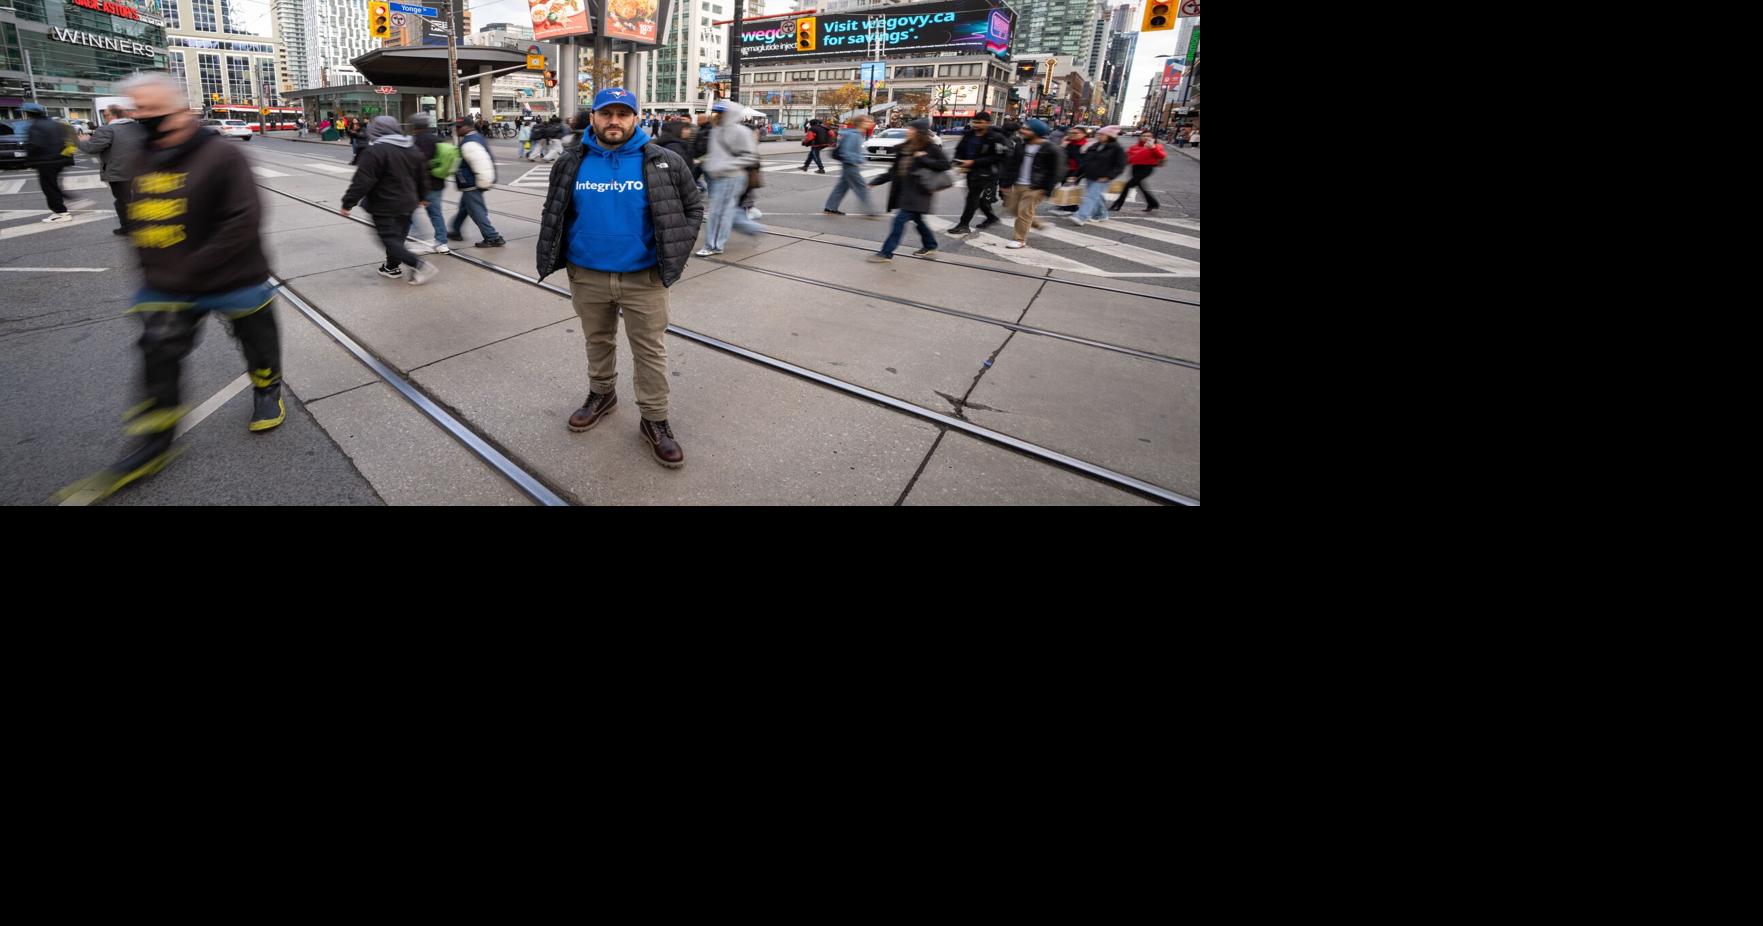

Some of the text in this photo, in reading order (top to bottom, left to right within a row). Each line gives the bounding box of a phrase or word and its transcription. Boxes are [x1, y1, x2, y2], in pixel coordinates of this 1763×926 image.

[401, 5, 422, 14] Yonge
[824, 11, 955, 33] Visit wegovy.ca
[53, 26, 155, 57] WINNERS
[823, 34, 844, 46] for
[575, 180, 644, 192] IntegrityTO
